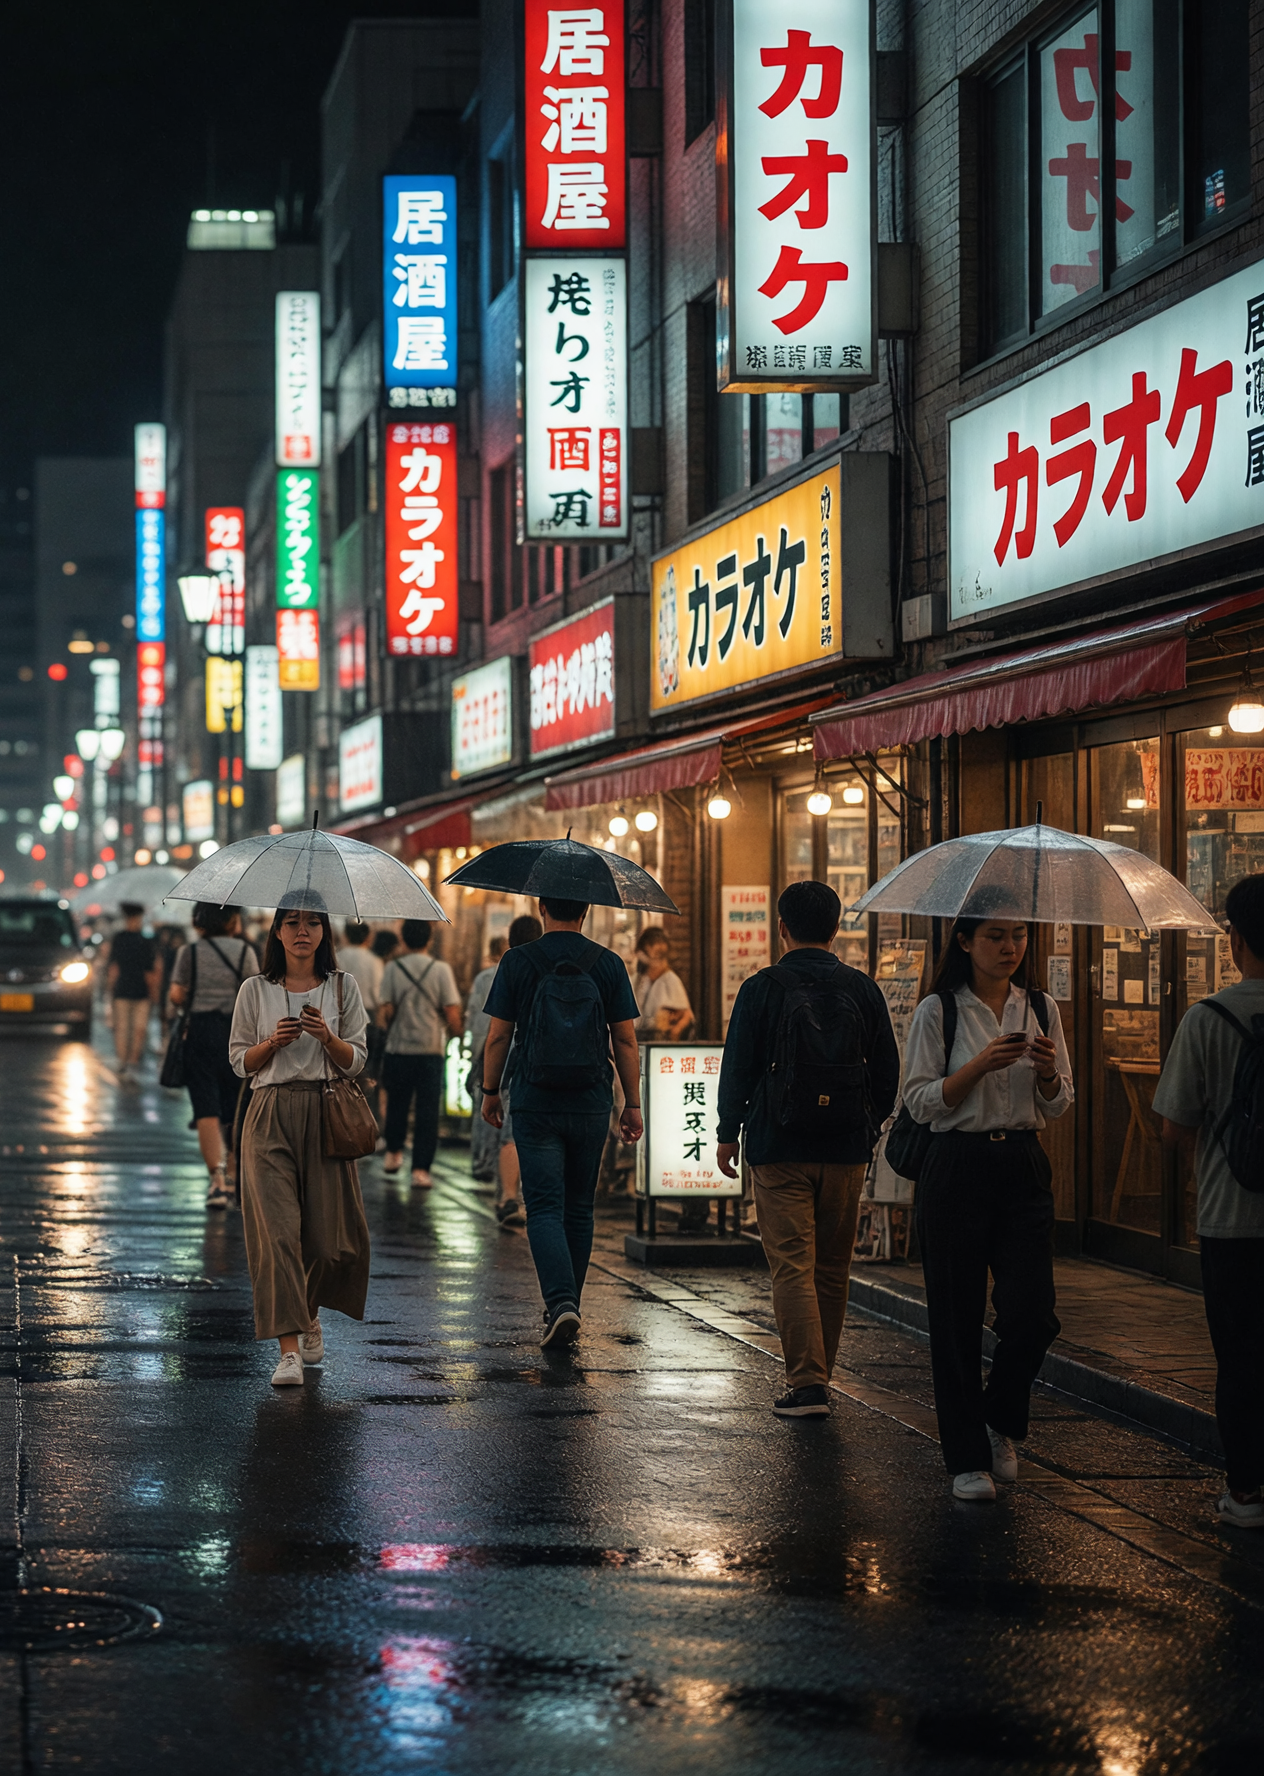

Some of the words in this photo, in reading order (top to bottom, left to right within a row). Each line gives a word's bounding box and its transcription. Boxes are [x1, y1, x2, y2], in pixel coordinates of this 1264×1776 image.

[540, 8, 611, 230] 居酒屋
[757, 29, 849, 336] カオケ
[392, 190, 449, 371] 居酒屋
[398, 447, 445, 636] カラオケ
[993, 347, 1234, 568] カラオケ
[687, 527, 806, 669] カラオケ
